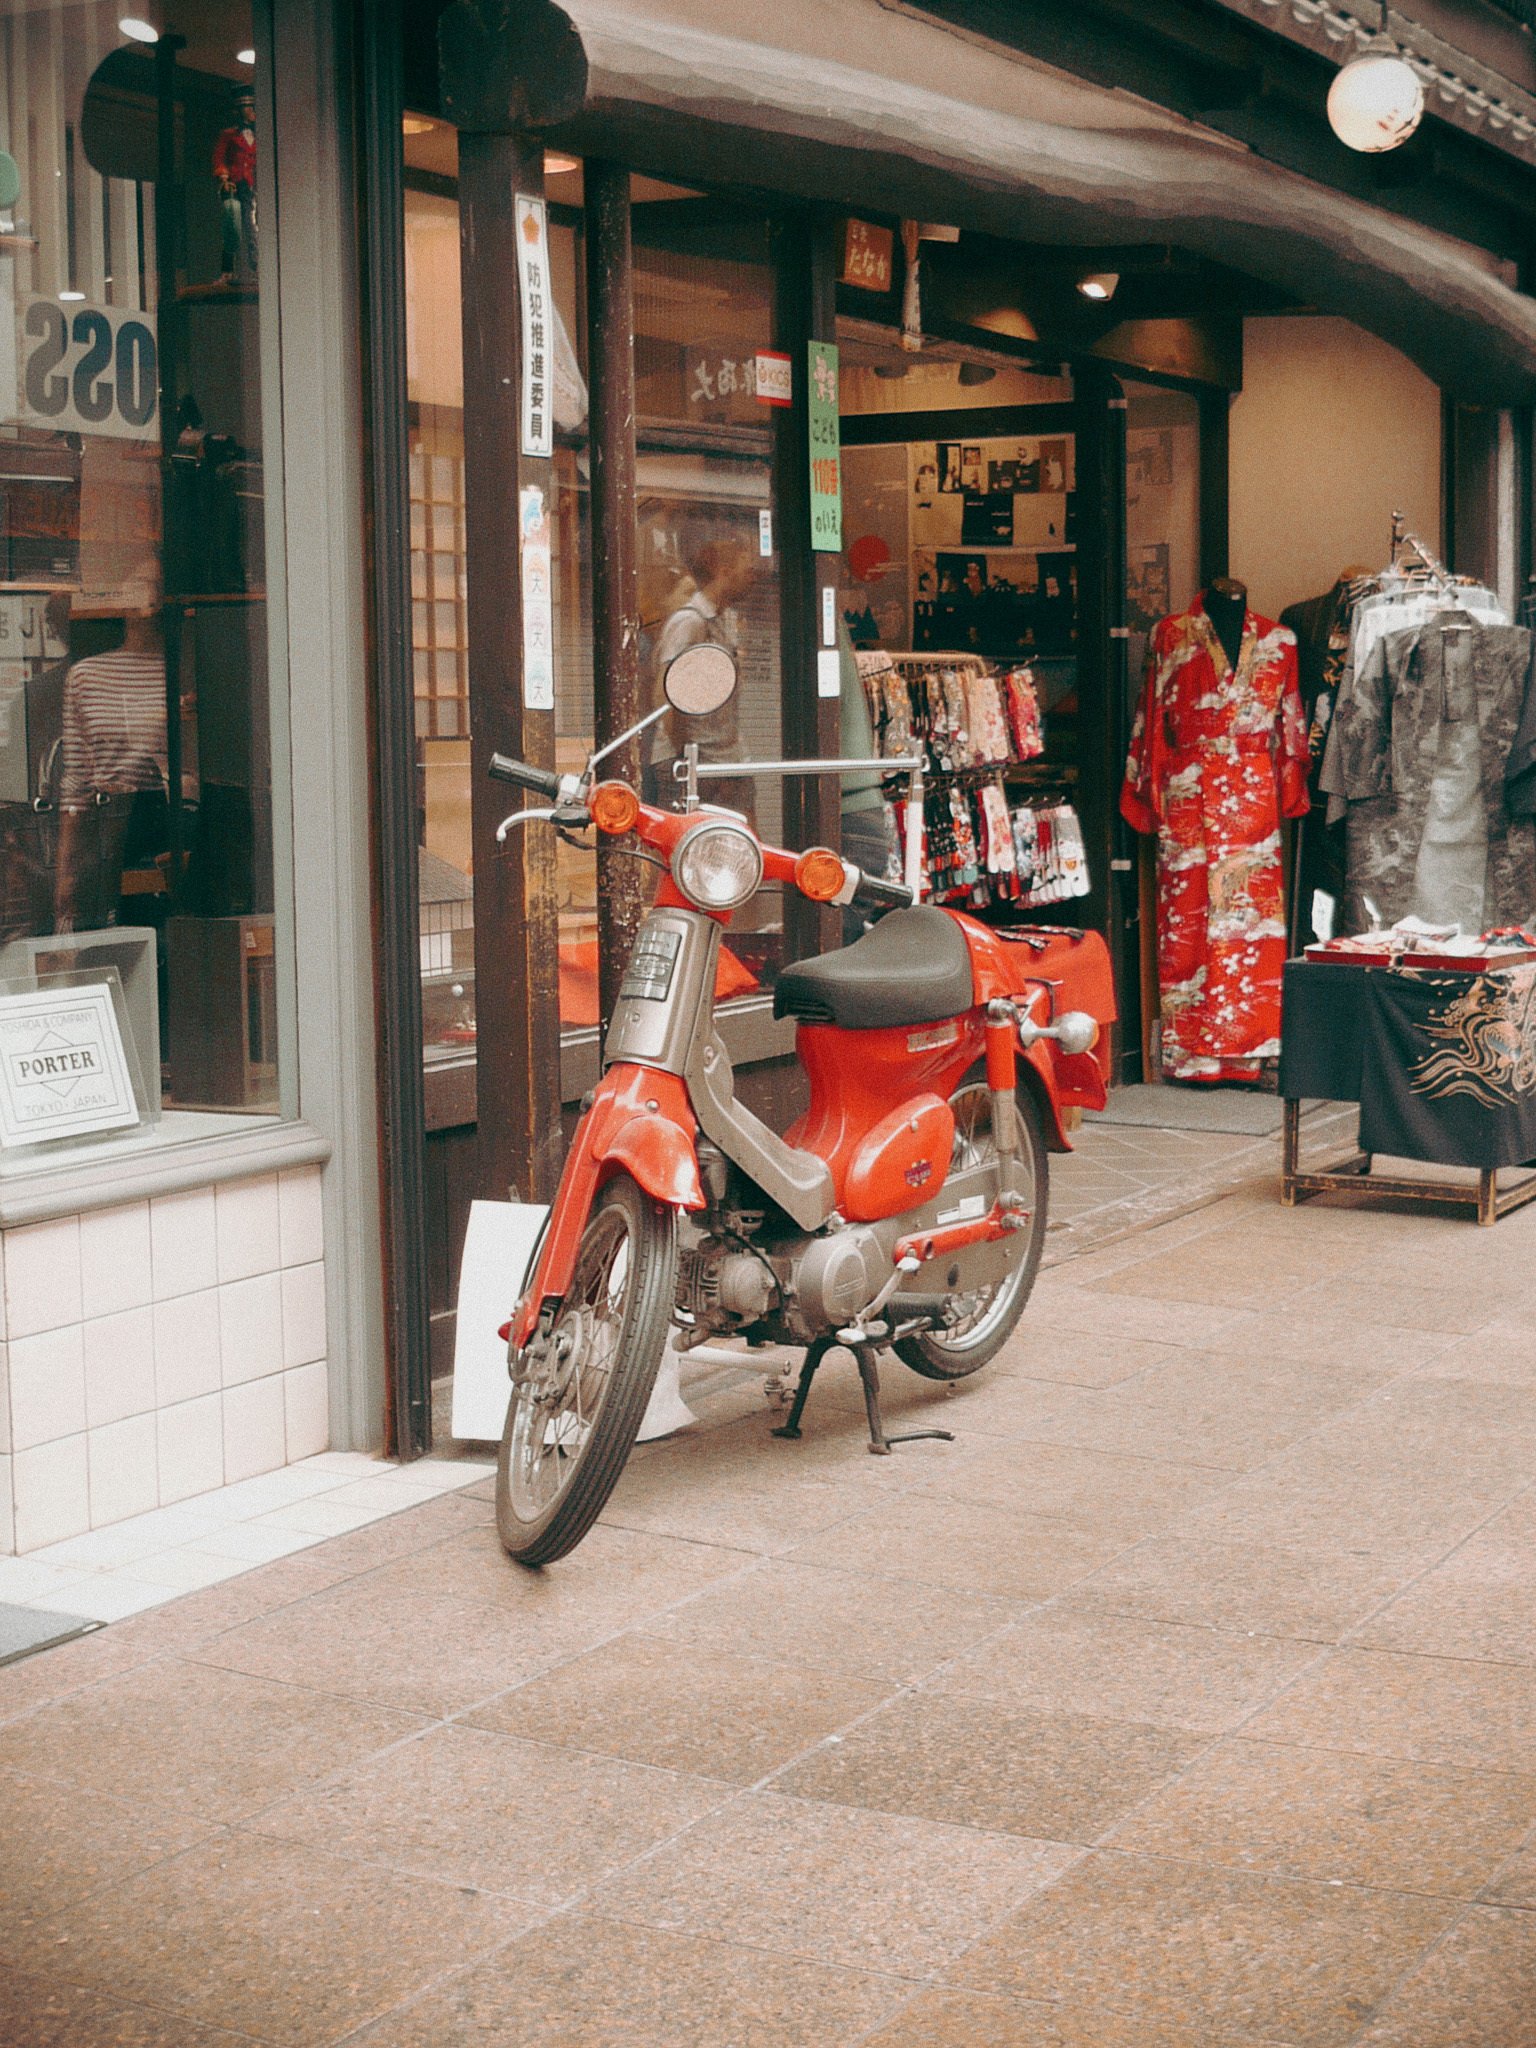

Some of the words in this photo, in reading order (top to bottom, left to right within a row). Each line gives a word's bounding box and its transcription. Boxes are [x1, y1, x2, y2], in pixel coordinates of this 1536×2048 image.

[526, 262, 544, 440] 防犯推進委員
[812, 418, 837, 445] こども
[815, 509, 839, 535] のいえ
[43, 1016, 50, 1029] &
[50, 1012, 93, 1027] COMPANY
[18, 1050, 95, 1078] PORTER
[25, 1100, 63, 1116] TOKYO
[73, 1095, 107, 1110] JAPAN
